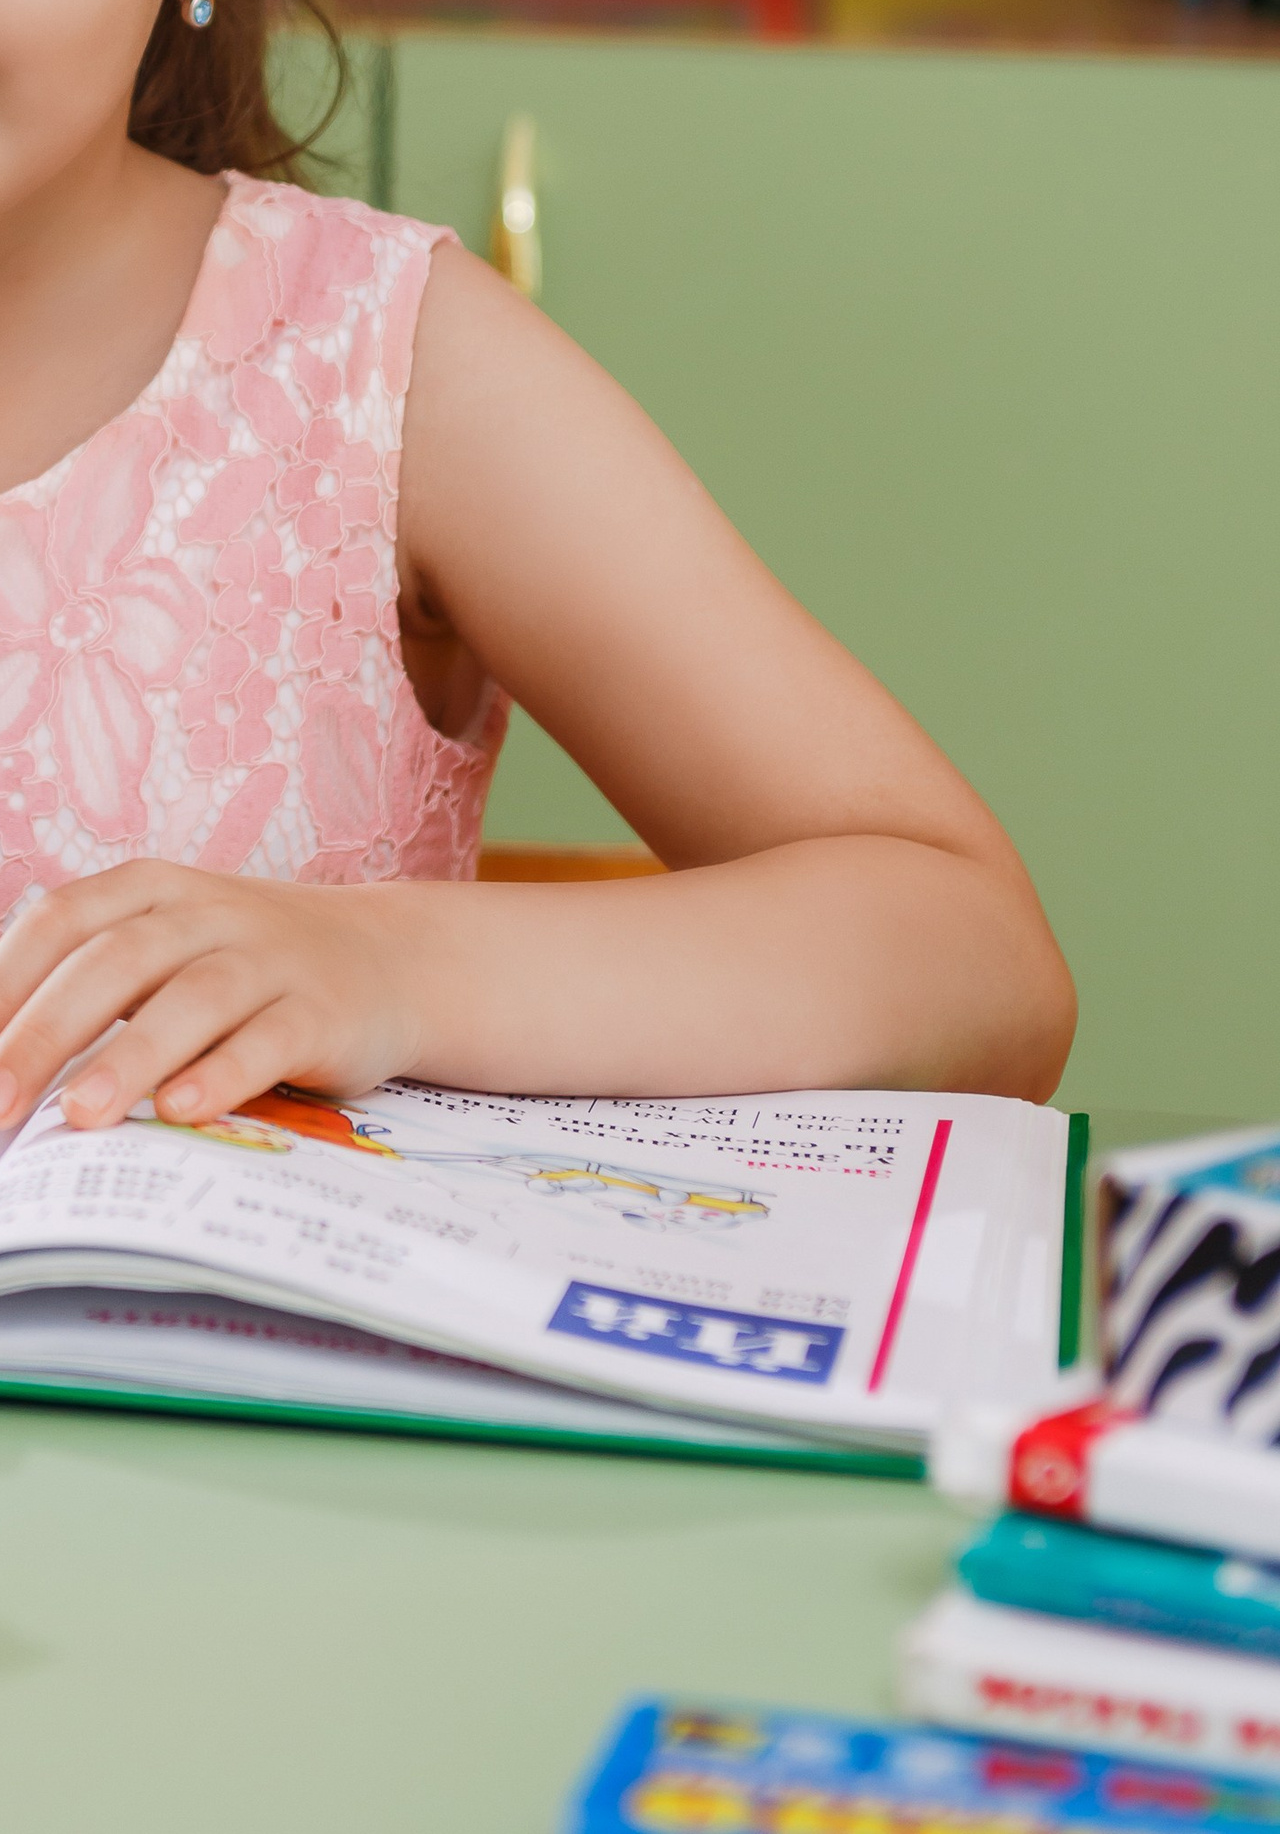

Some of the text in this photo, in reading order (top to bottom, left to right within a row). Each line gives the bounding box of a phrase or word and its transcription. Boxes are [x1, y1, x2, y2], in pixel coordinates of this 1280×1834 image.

[374, 1085, 471, 1115] Зи-н
[612, 1100, 904, 1125] пи-лой ру-кой
[634, 1112, 735, 1126] ру-ка
[548, 1117, 639, 1133] спит
[796, 1124, 901, 1135] пи-ла
[549, 1124, 691, 1148] сан-ки.
[664, 1131, 818, 1148] сан-ках
[717, 1146, 841, 1163] Зи-ны
[844, 1145, 895, 1155] На
[735, 1159, 893, 1178] Зи-мой.
[863, 1157, 895, 1165] У
